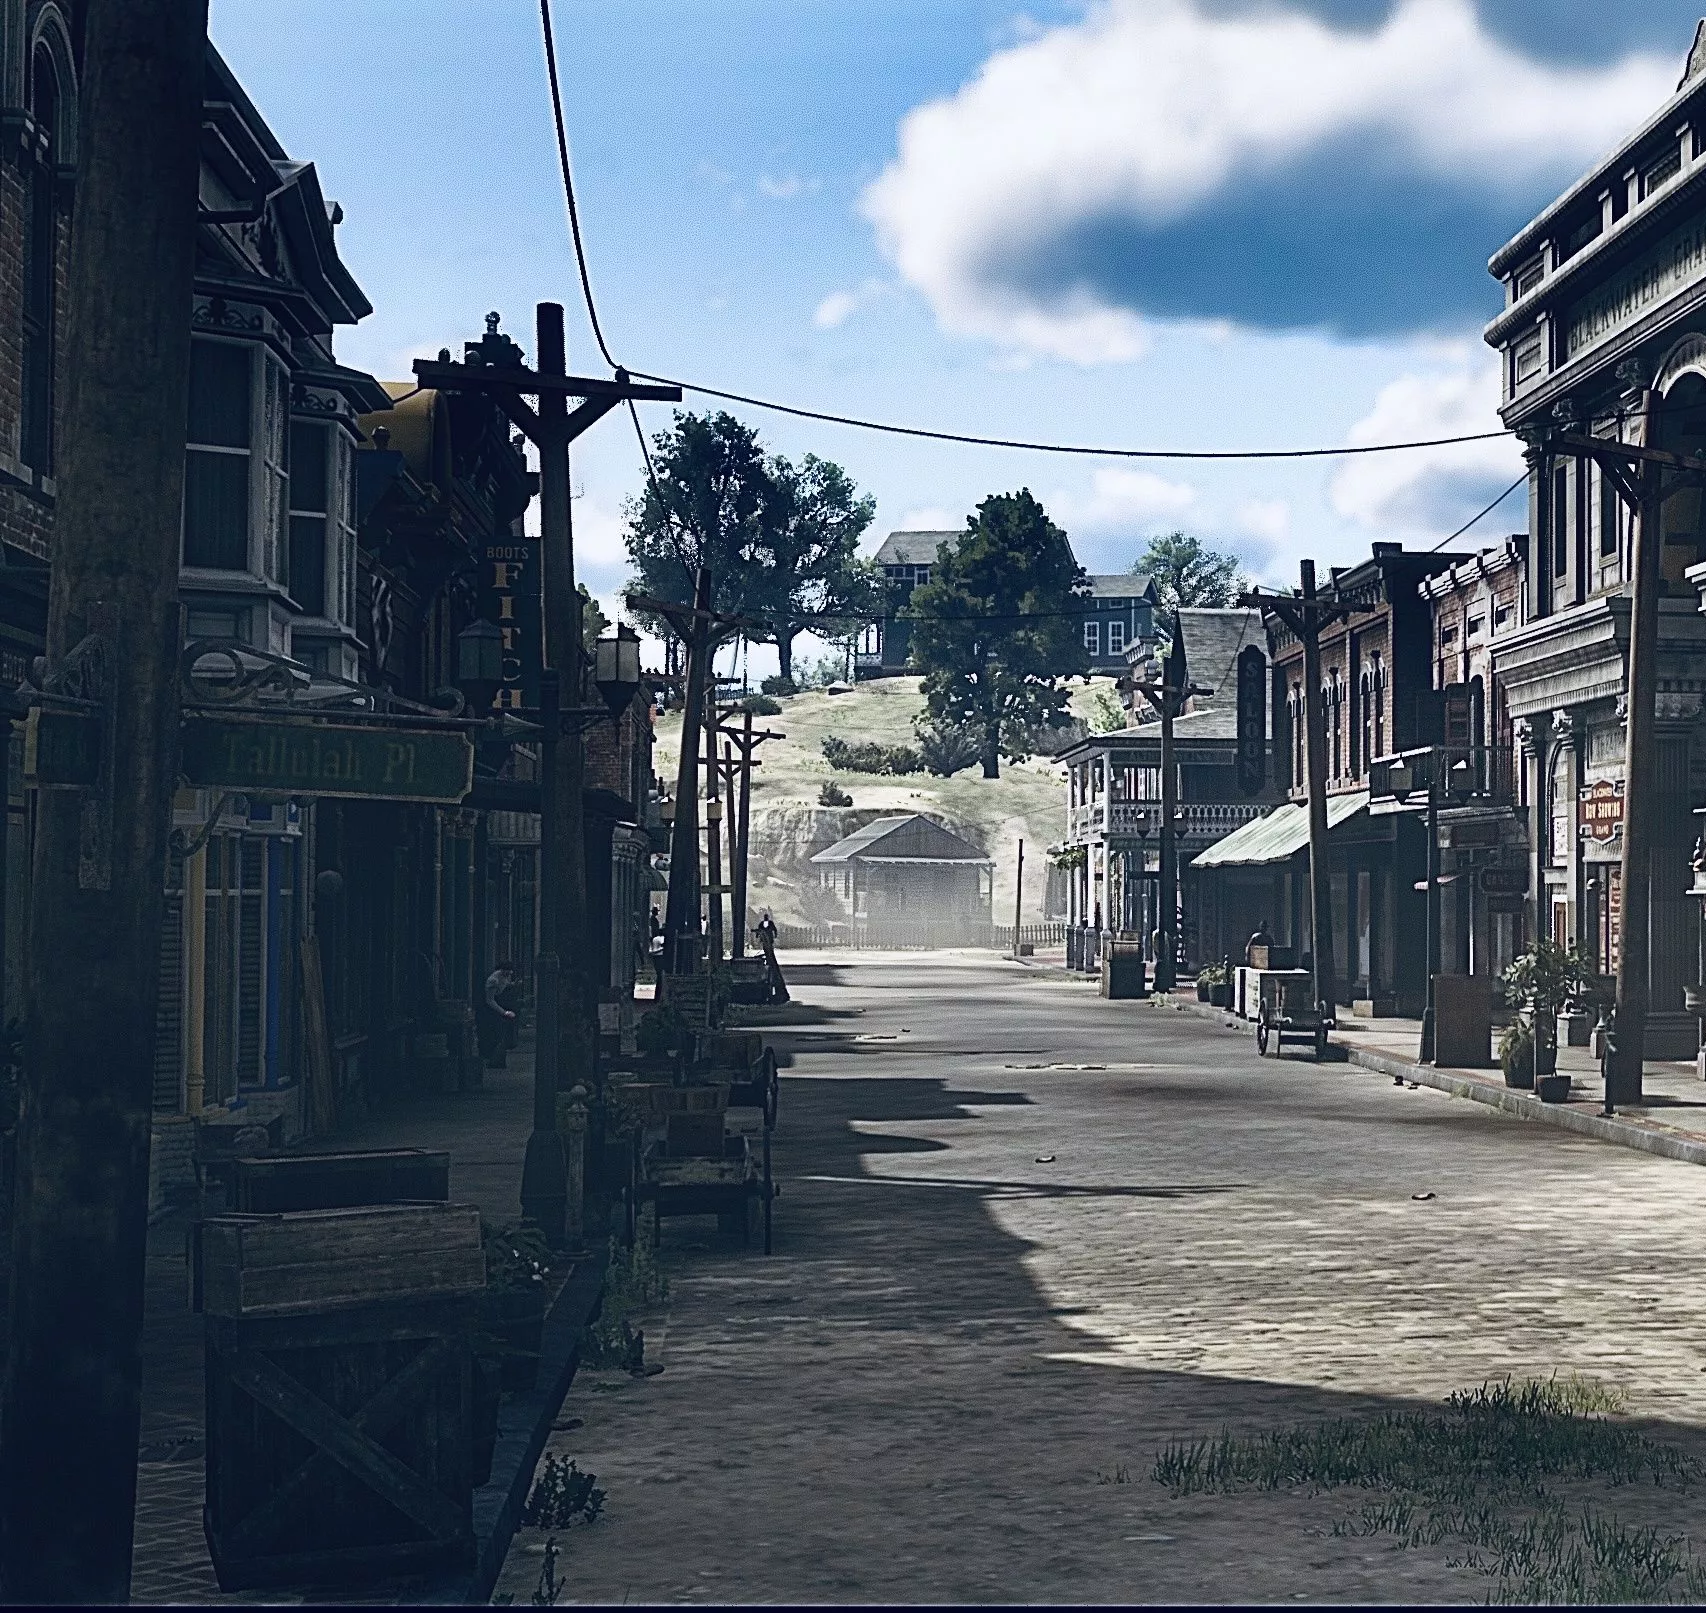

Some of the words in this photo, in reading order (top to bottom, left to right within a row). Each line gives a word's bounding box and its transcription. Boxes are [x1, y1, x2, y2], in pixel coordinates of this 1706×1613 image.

[1569, 264, 1660, 351] BLACKWATER
[485, 546, 529, 560] BOOTS
[222, 732, 363, 782] Tallulah
